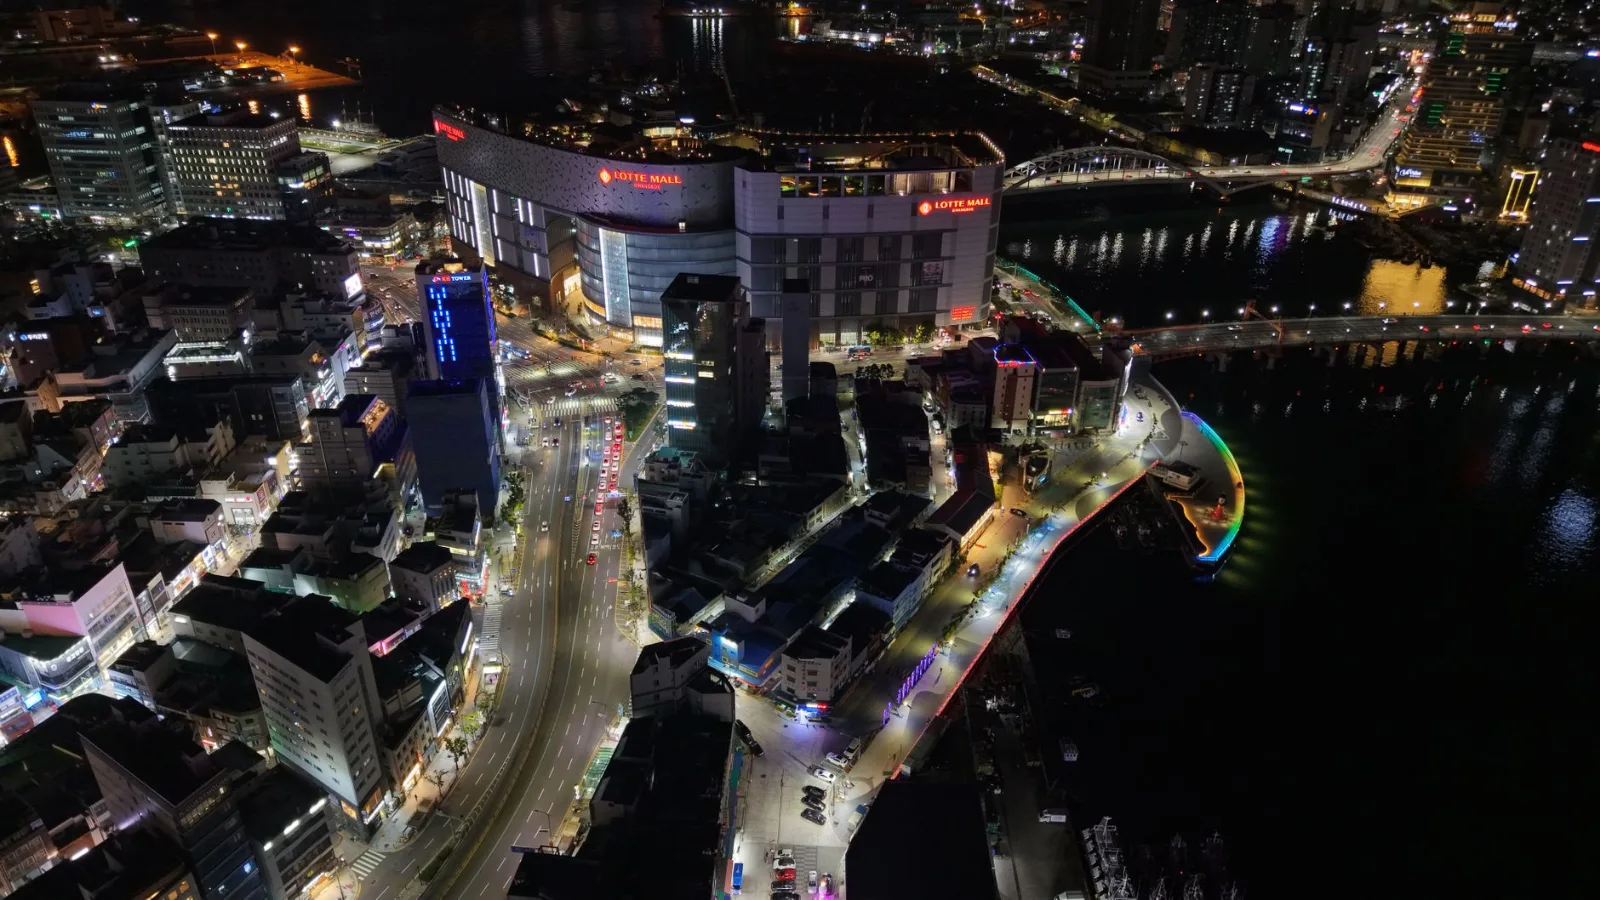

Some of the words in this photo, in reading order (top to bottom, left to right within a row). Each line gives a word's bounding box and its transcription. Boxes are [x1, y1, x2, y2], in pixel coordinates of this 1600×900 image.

[613, 171, 648, 183] LOTTE
[650, 175, 682, 184] MALL
[935, 200, 965, 209] LOTTE
[967, 198, 991, 206] MALL
